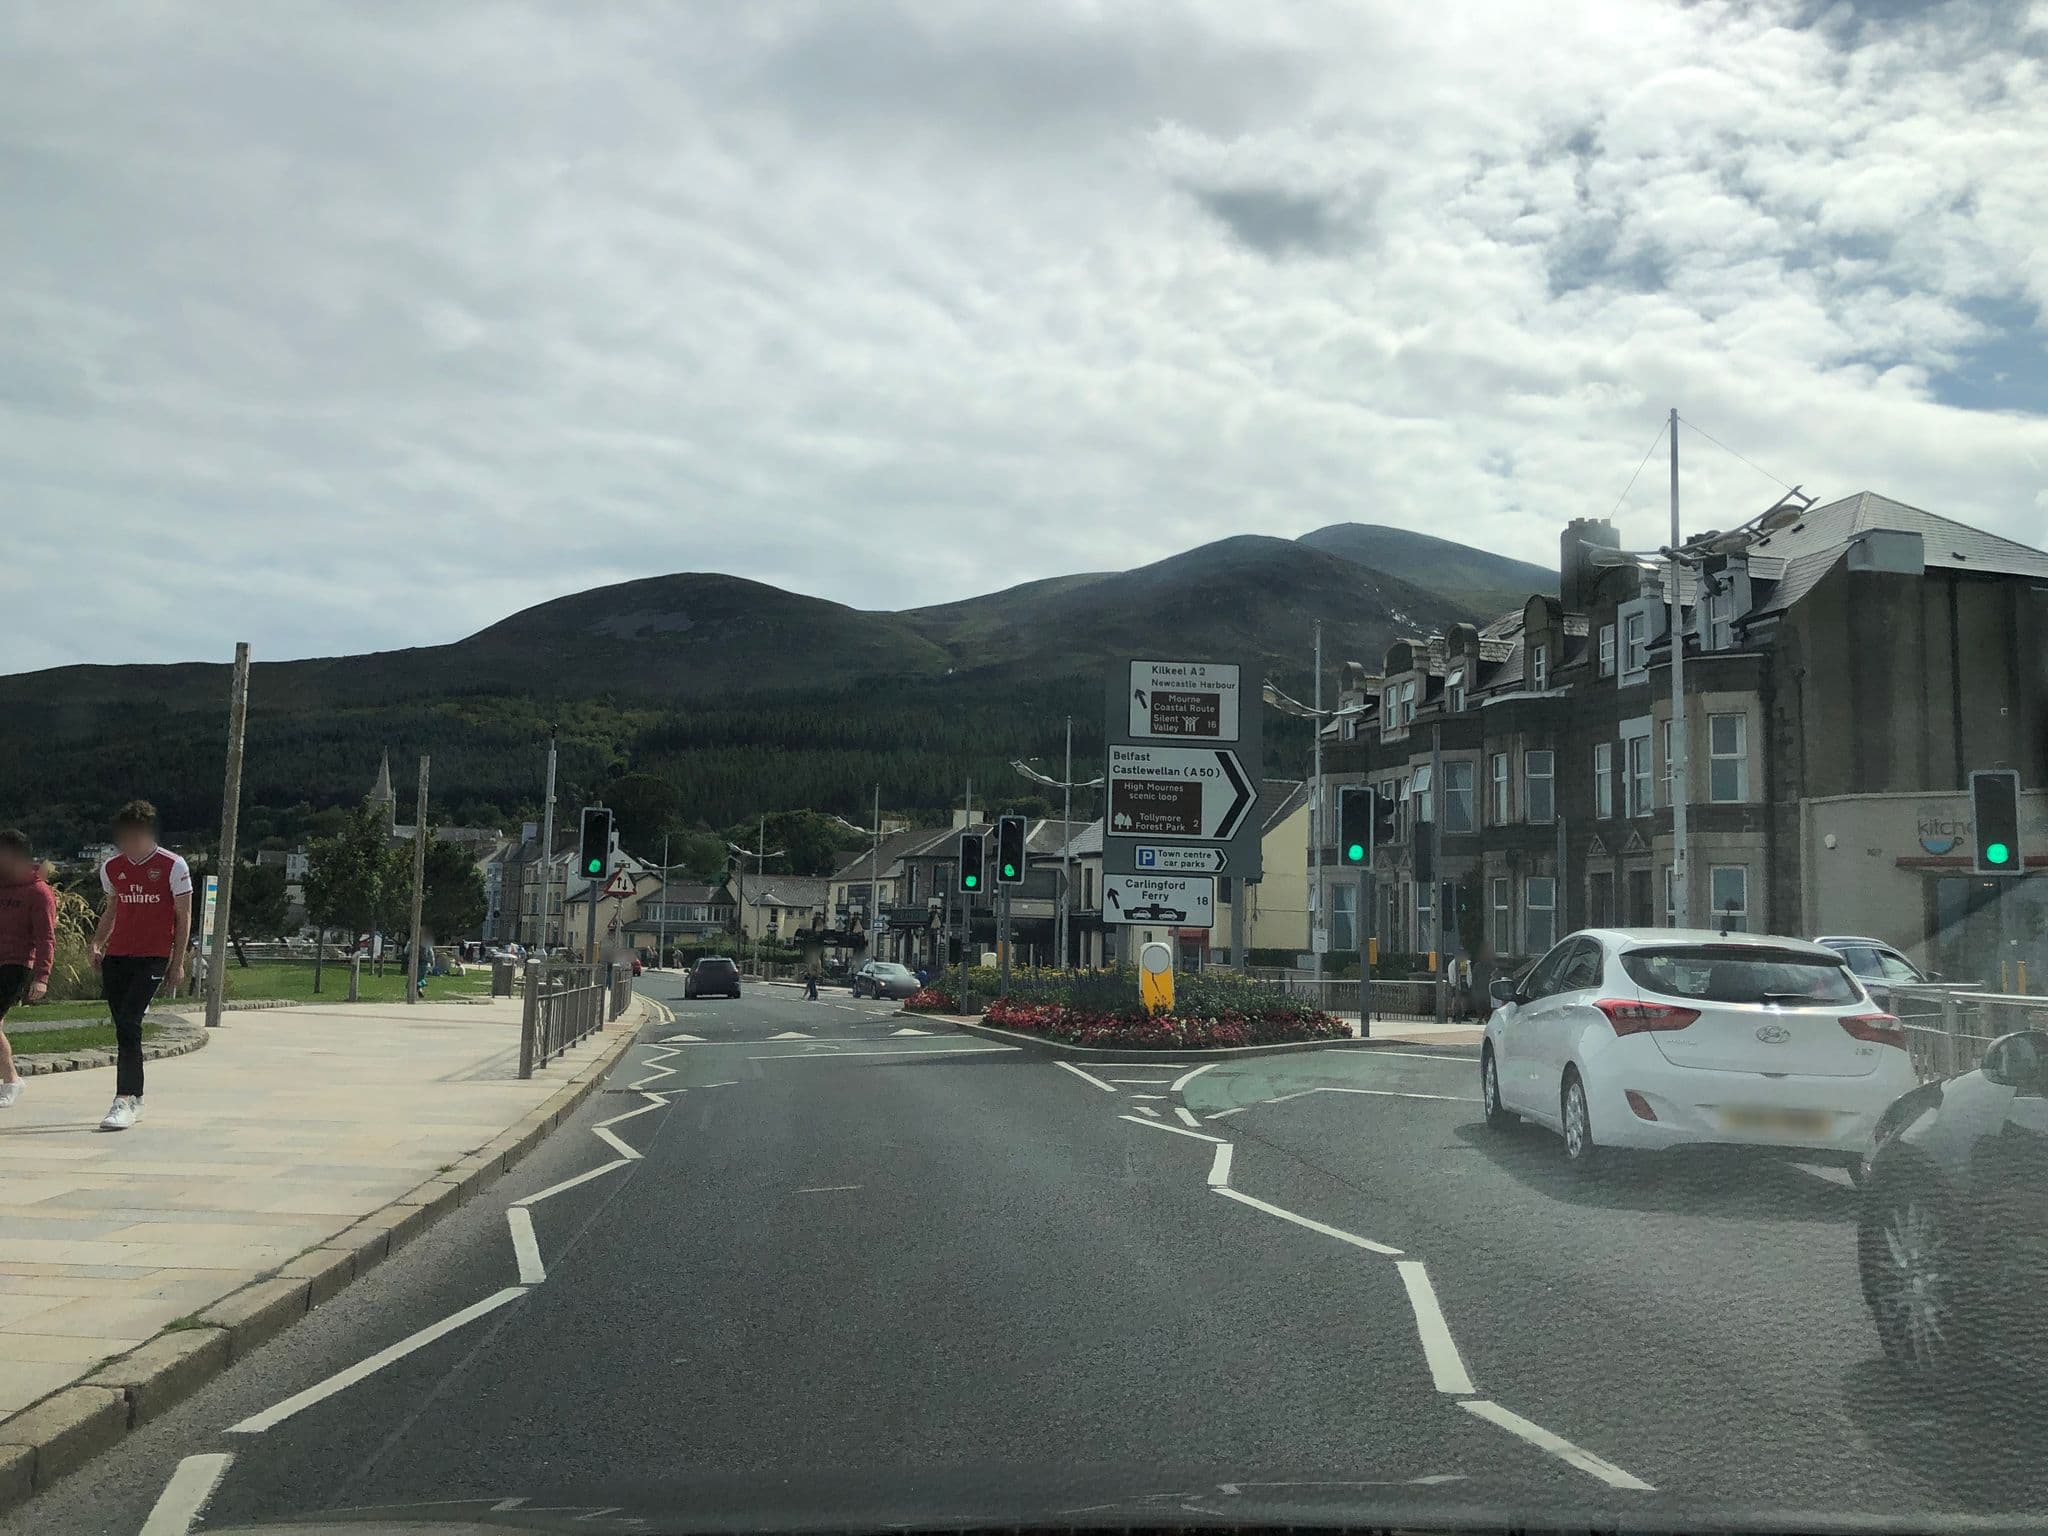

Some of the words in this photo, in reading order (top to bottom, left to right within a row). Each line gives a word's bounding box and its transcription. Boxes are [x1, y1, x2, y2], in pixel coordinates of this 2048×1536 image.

[1152, 666, 1187, 676] Kilkeel
[1152, 679, 1197, 688] Newcastle
[1200, 680, 1236, 690] Harbour
[1169, 695, 1201, 703] Mourne
[1154, 703, 1187, 712] Coastal
[1190, 704, 1215, 713] Route
[1154, 714, 1179, 723] Silent
[1154, 724, 1179, 733] Valley
[1114, 752, 1151, 761] Belfast
[1113, 765, 1180, 776] Castlewellan
[1124, 783, 1144, 791] High
[1147, 784, 1184, 792] Mournes
[1159, 793, 1178, 802] loop
[1140, 813, 1182, 823] Tollymore
[1136, 822, 1163, 831] Forest
[1167, 823, 1186, 832] Park
[1193, 820, 1199, 828] 2
[1158, 850, 1180, 858] Town
[1184, 851, 1212, 859] centre
[1179, 860, 1205, 870] parks
[130, 884, 143, 894] Fly
[1126, 879, 1186, 890] Carlingford
[1142, 891, 1169, 902] Ferry
[1197, 897, 1208, 905] 18
